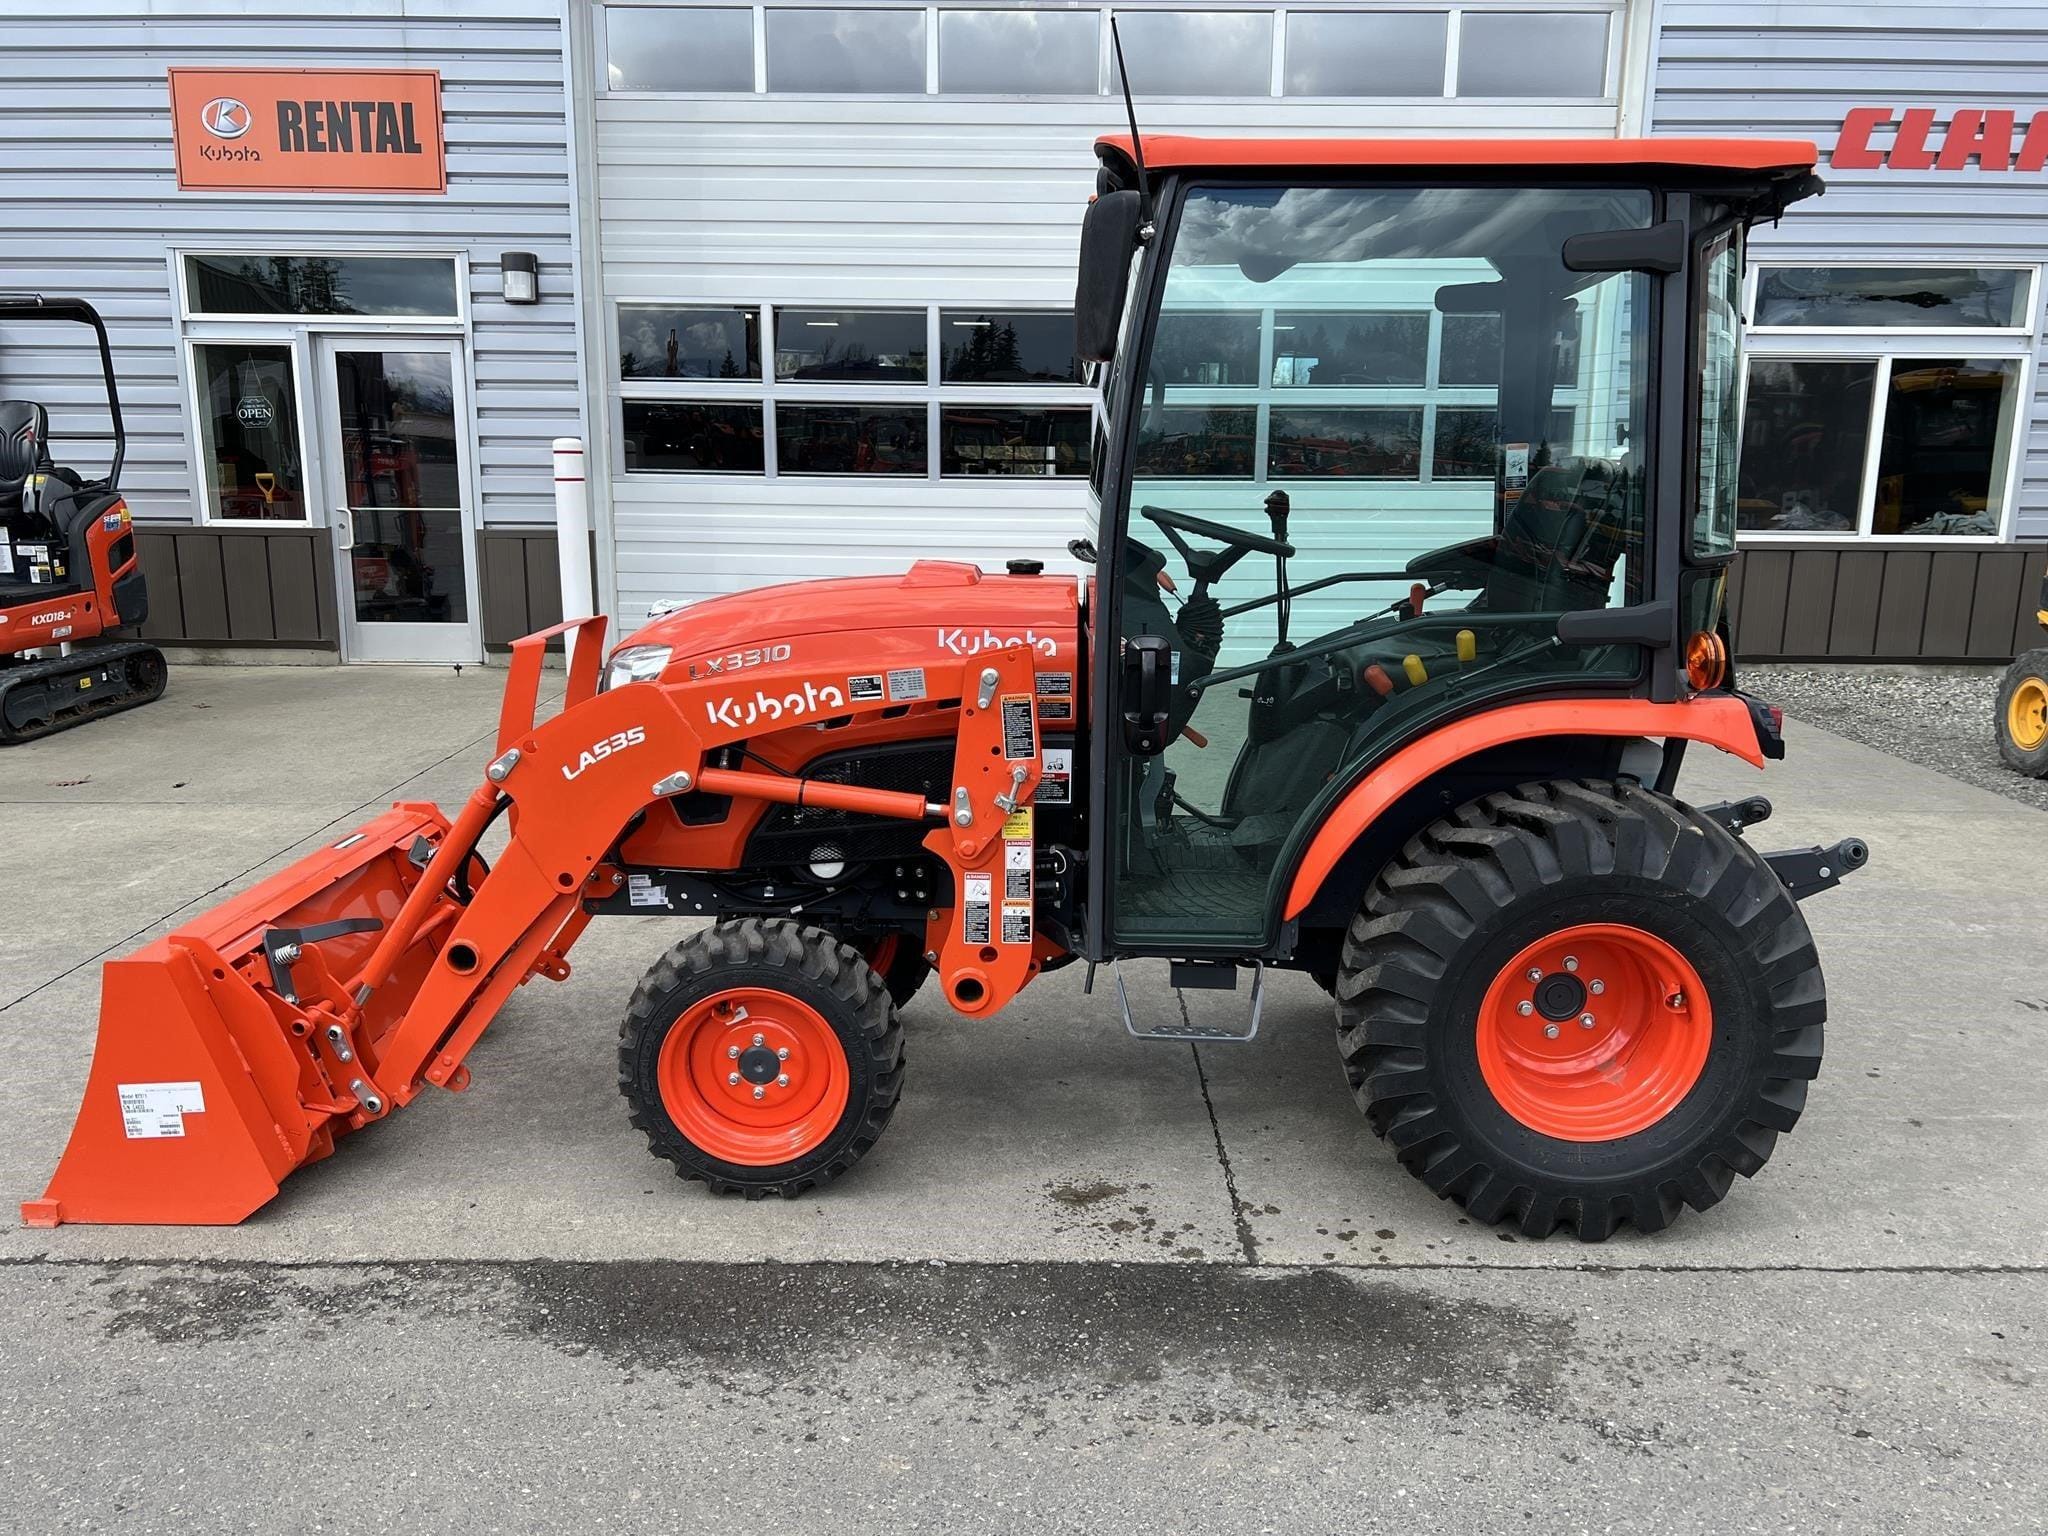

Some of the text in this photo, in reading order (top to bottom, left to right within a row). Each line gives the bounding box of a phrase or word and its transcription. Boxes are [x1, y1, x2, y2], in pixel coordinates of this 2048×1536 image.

[276, 100, 422, 154] RENTAL
[200, 145, 262, 162] Kubota
[238, 408, 272, 419] OPEN
[31, 611, 72, 626] KX018-4
[688, 644, 792, 680] LX3310
[706, 682, 845, 729] Kubota
[561, 726, 646, 781] LA535
[176, 1104, 184, 1112] 12
